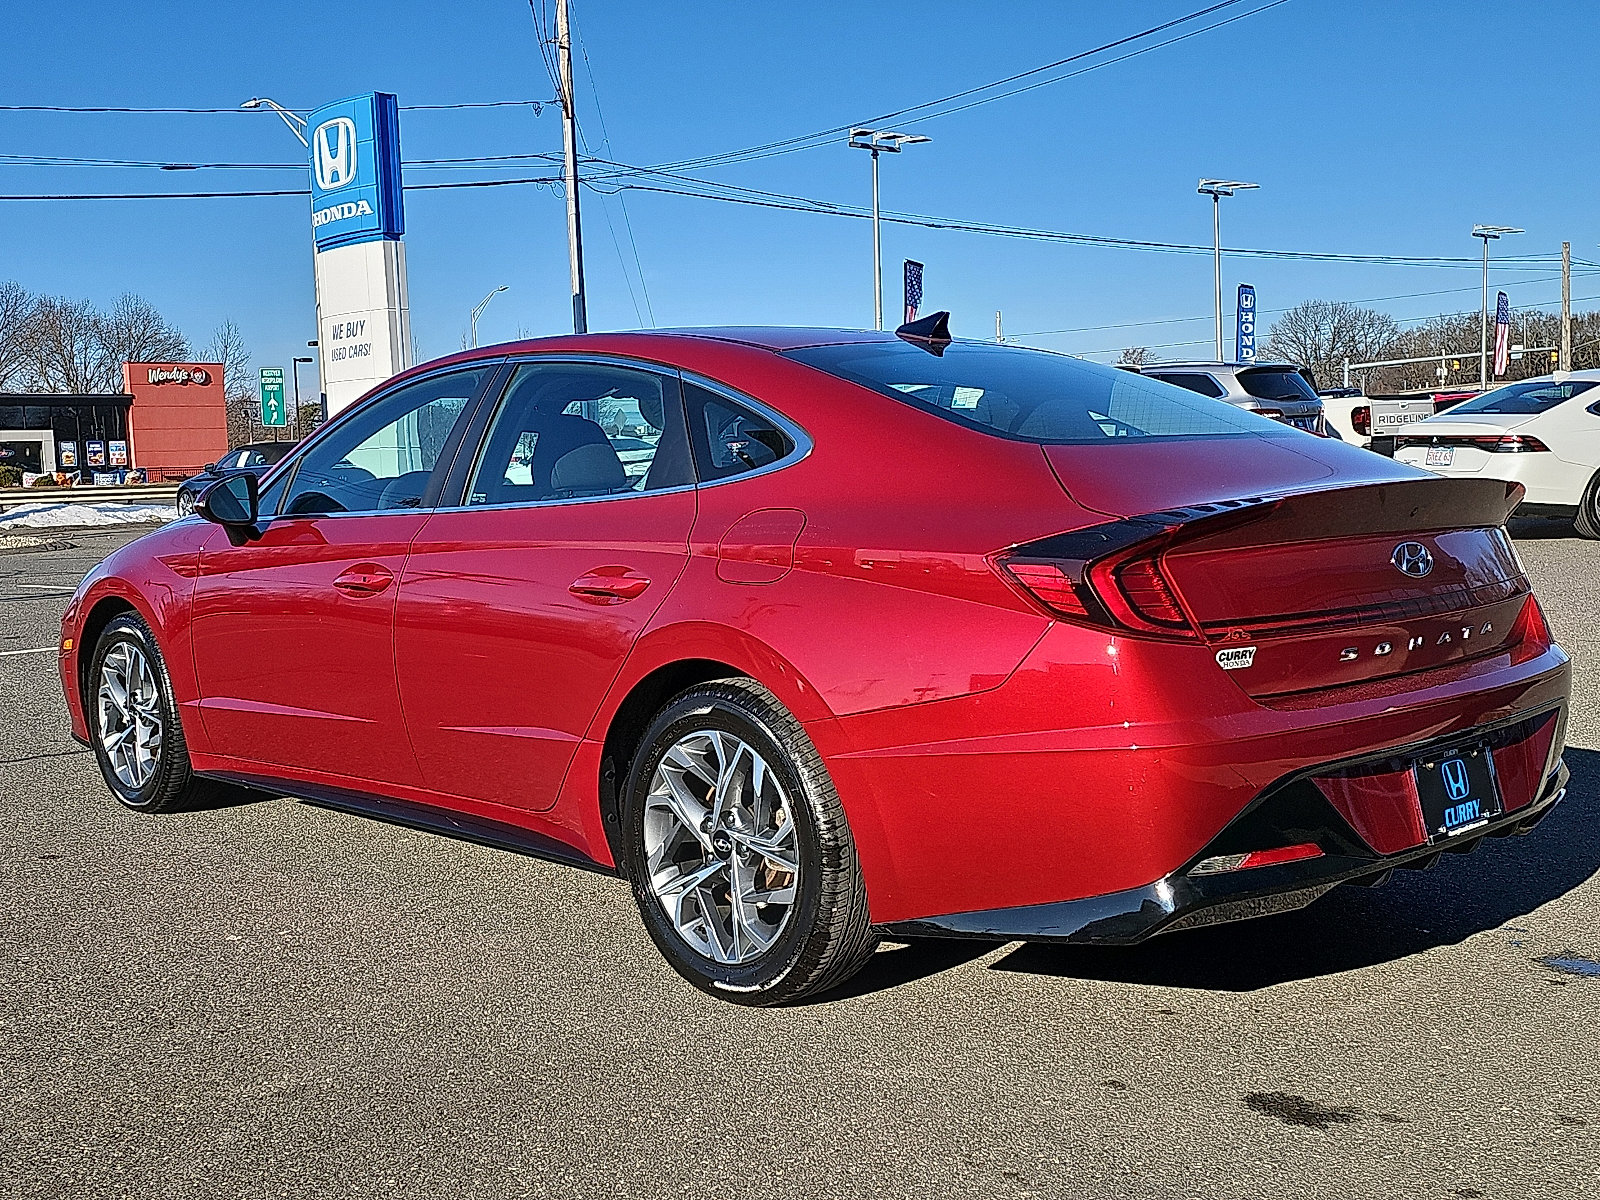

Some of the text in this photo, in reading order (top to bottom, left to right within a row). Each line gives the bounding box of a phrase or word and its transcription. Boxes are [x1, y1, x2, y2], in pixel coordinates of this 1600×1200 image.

[313, 200, 374, 228] HONDA
[332, 320, 366, 341] WE BUY
[331, 343, 372, 362] USED CARS!
[147, 366, 189, 383] Wendy's
[1340, 620, 1493, 662] SONATA
[1218, 649, 1255, 662] CURRY
[1223, 660, 1250, 668] HONDA
[1444, 798, 1481, 828] CURRY
